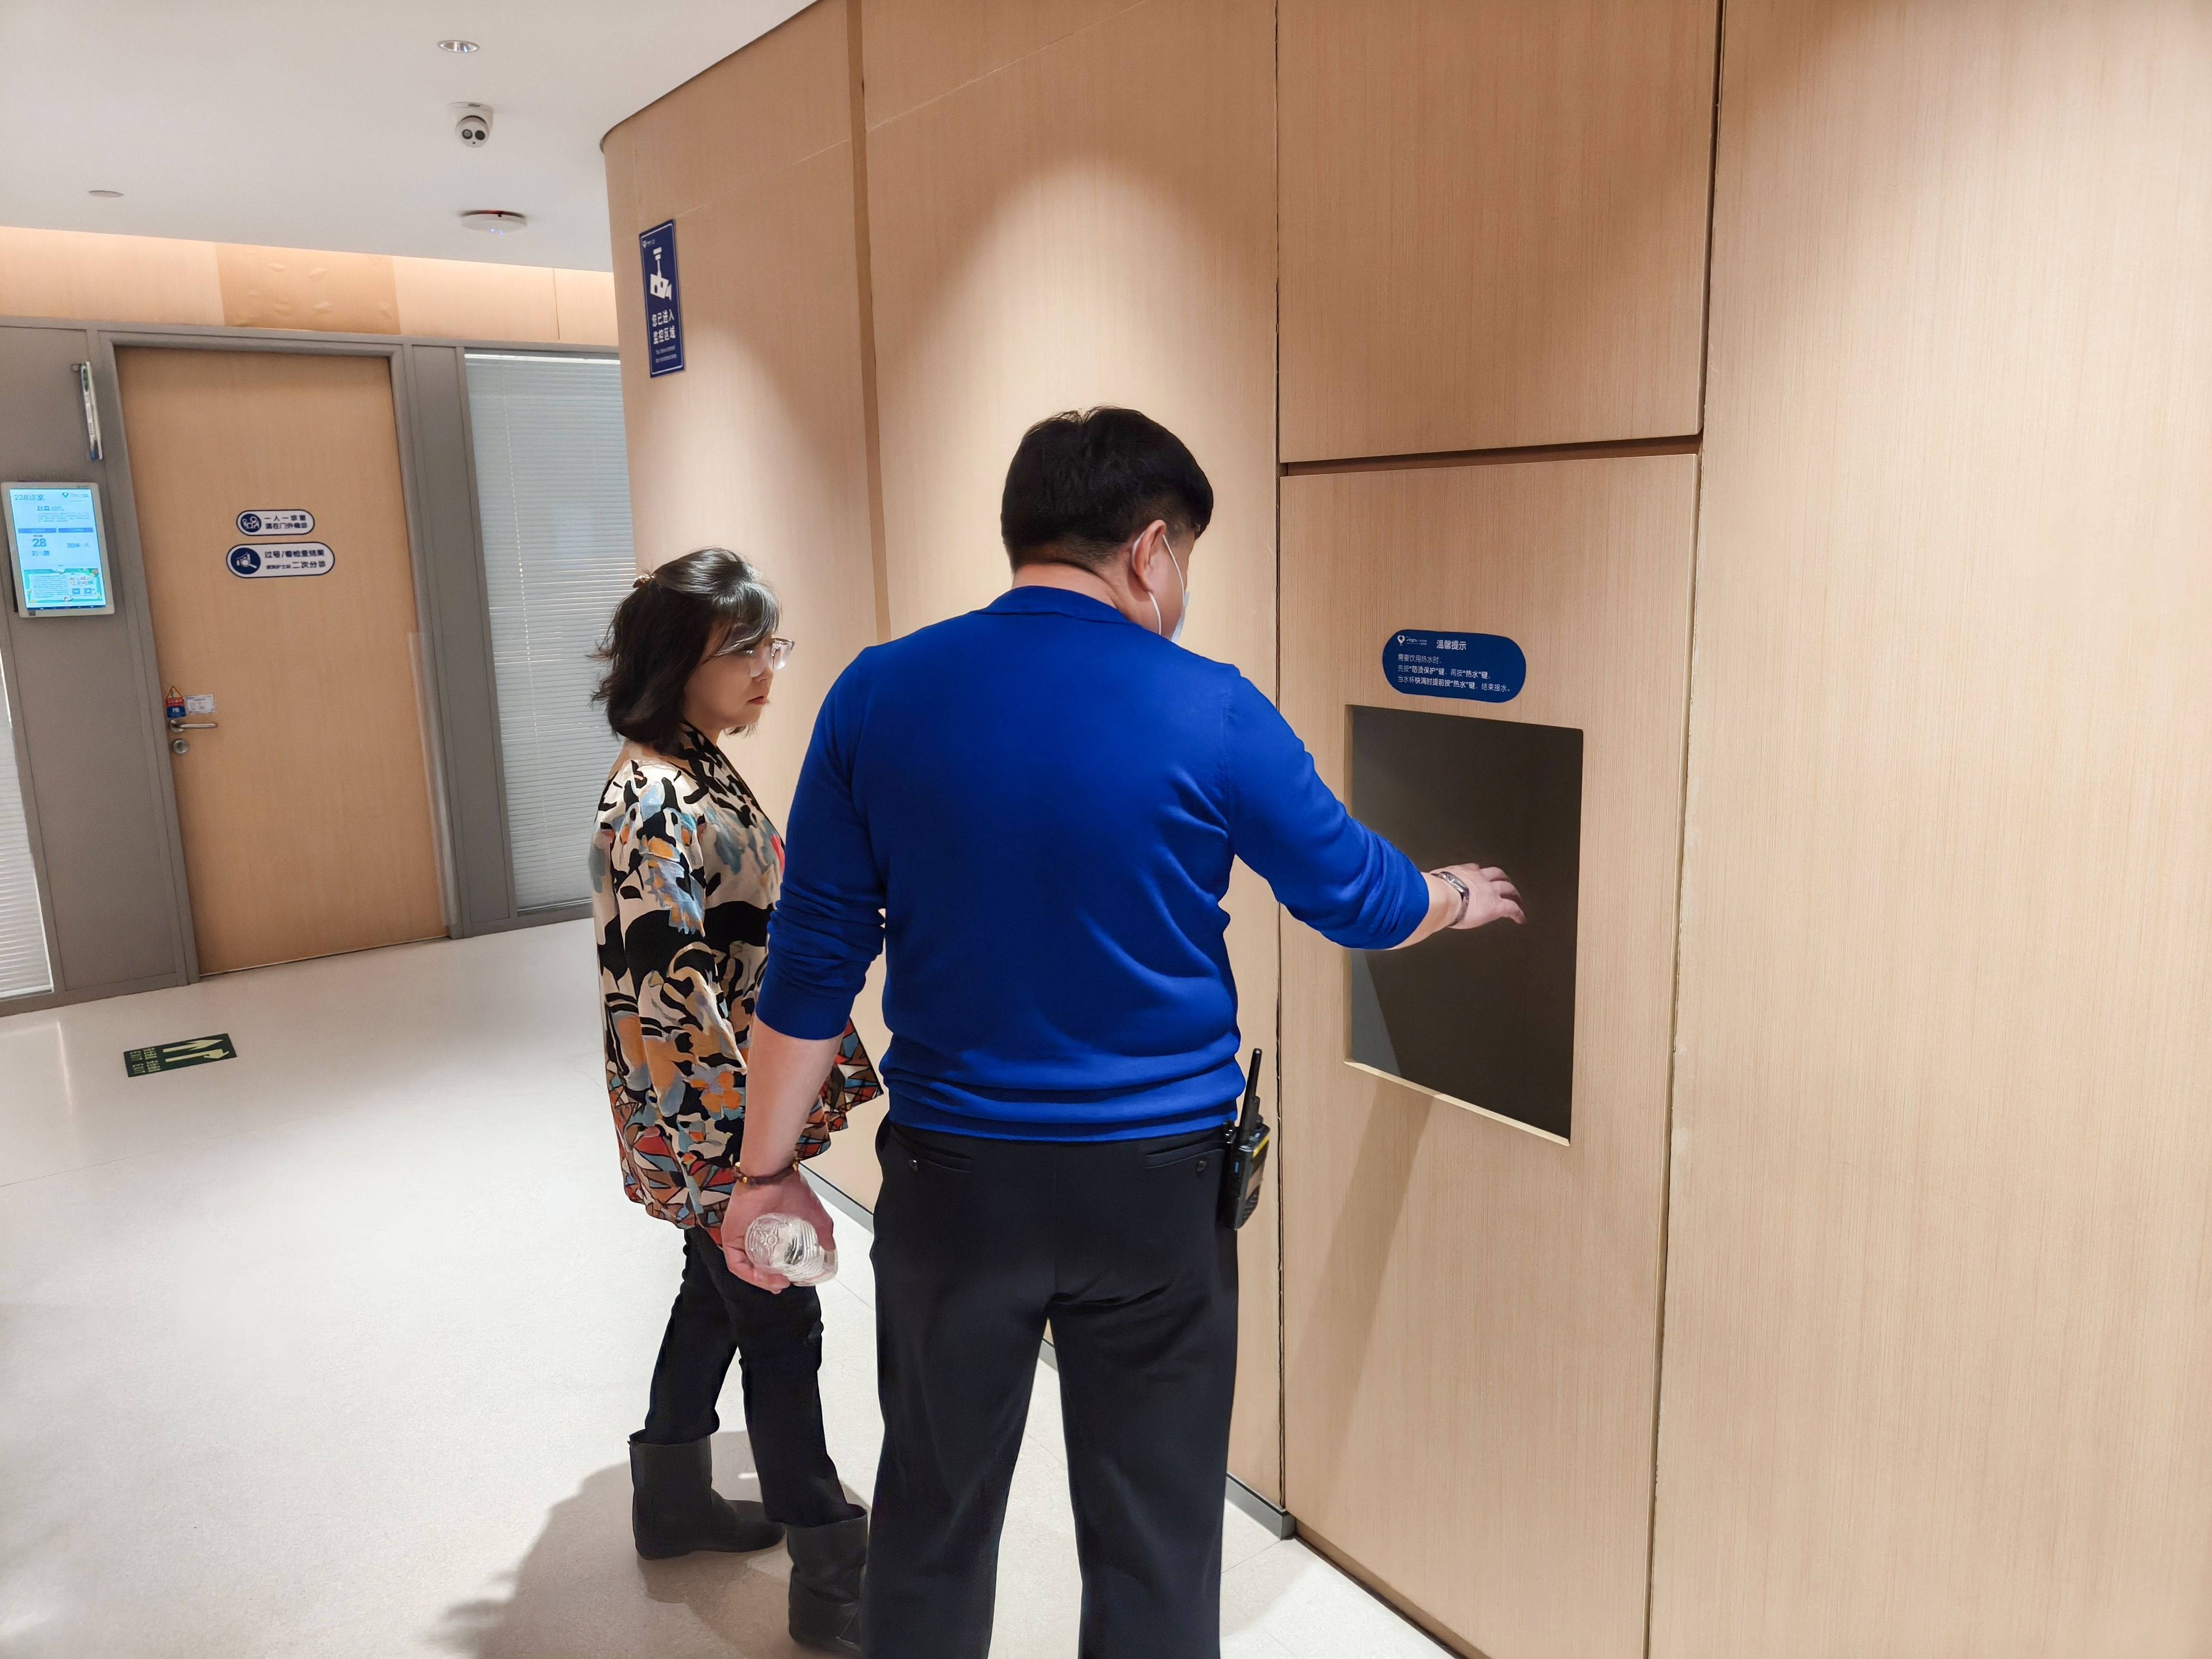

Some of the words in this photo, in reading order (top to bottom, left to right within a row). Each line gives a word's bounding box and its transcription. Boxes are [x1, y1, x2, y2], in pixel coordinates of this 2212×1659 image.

[32, 538, 47, 547] 28
[1436, 639, 1467, 651] 温馨提示
